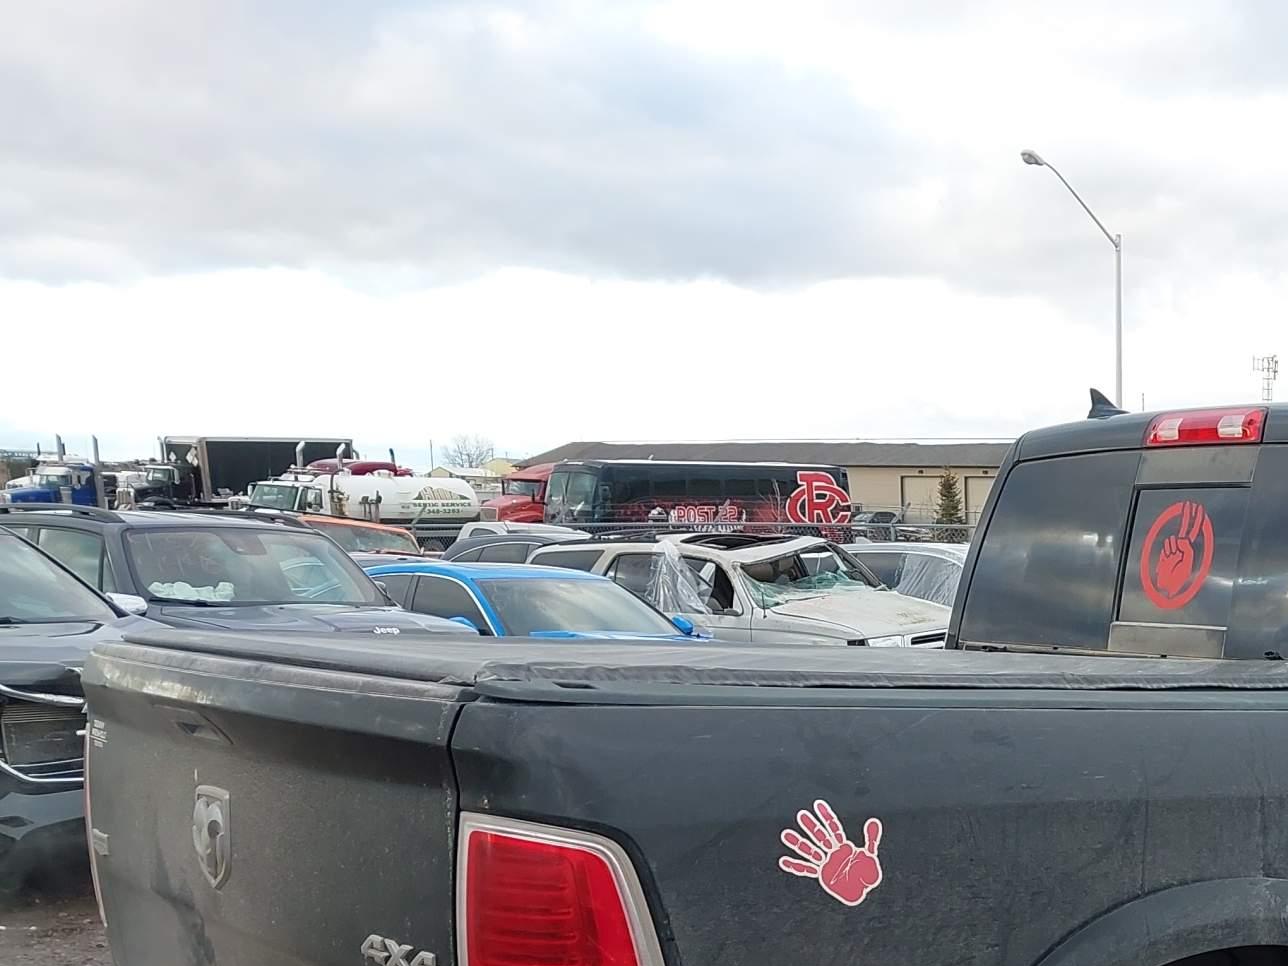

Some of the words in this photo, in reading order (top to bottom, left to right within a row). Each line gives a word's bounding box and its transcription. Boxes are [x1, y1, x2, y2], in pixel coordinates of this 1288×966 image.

[675, 505, 717, 523] POST
[718, 505, 738, 523] 22
[373, 626, 401, 635] Jeep
